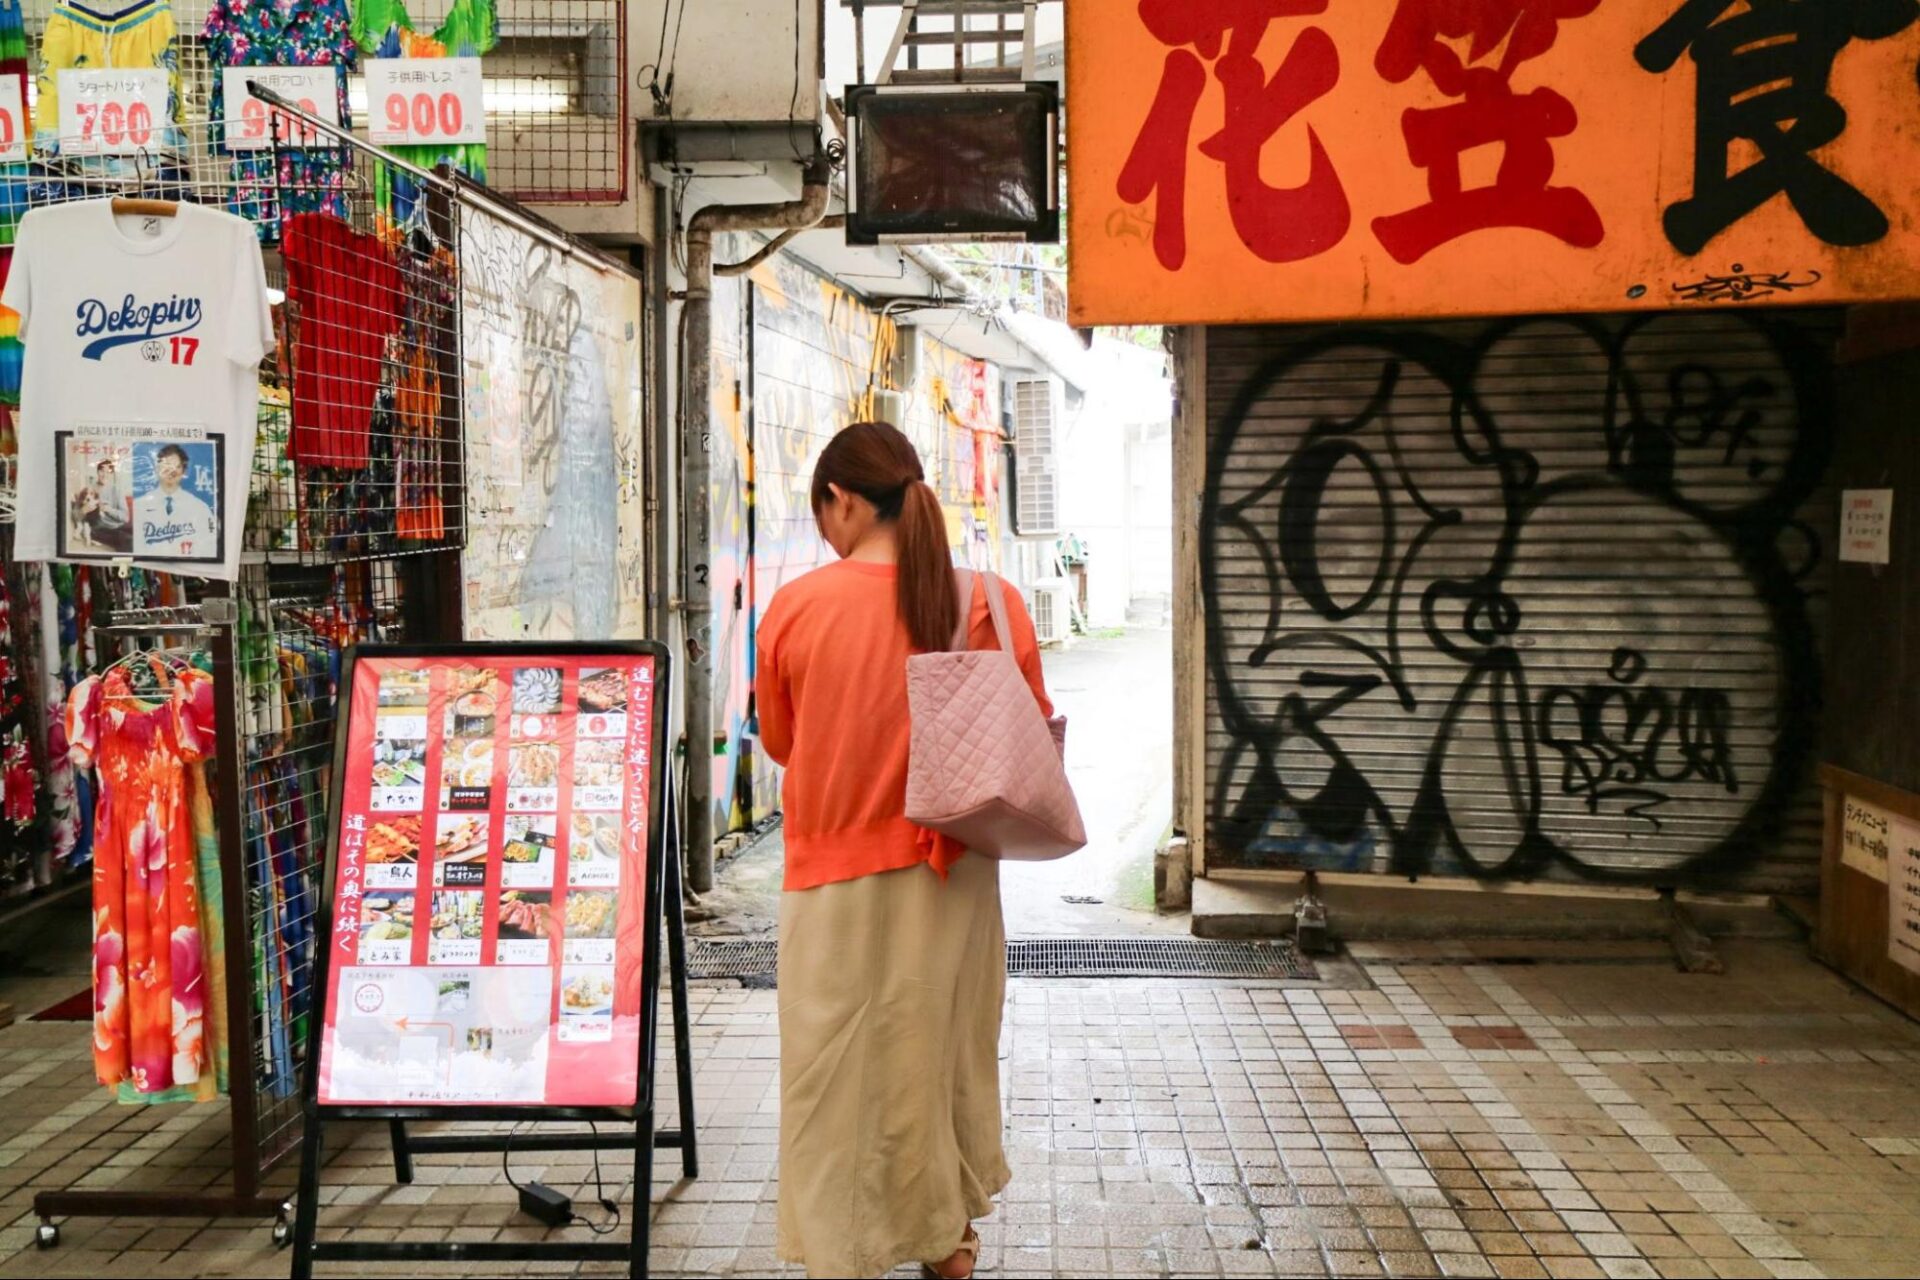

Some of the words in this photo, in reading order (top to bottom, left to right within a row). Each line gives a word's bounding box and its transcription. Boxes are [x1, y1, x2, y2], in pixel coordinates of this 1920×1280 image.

[76, 293, 202, 338] Dekopin
[169, 336, 200, 366] 17
[143, 521, 196, 544] Dodgers
